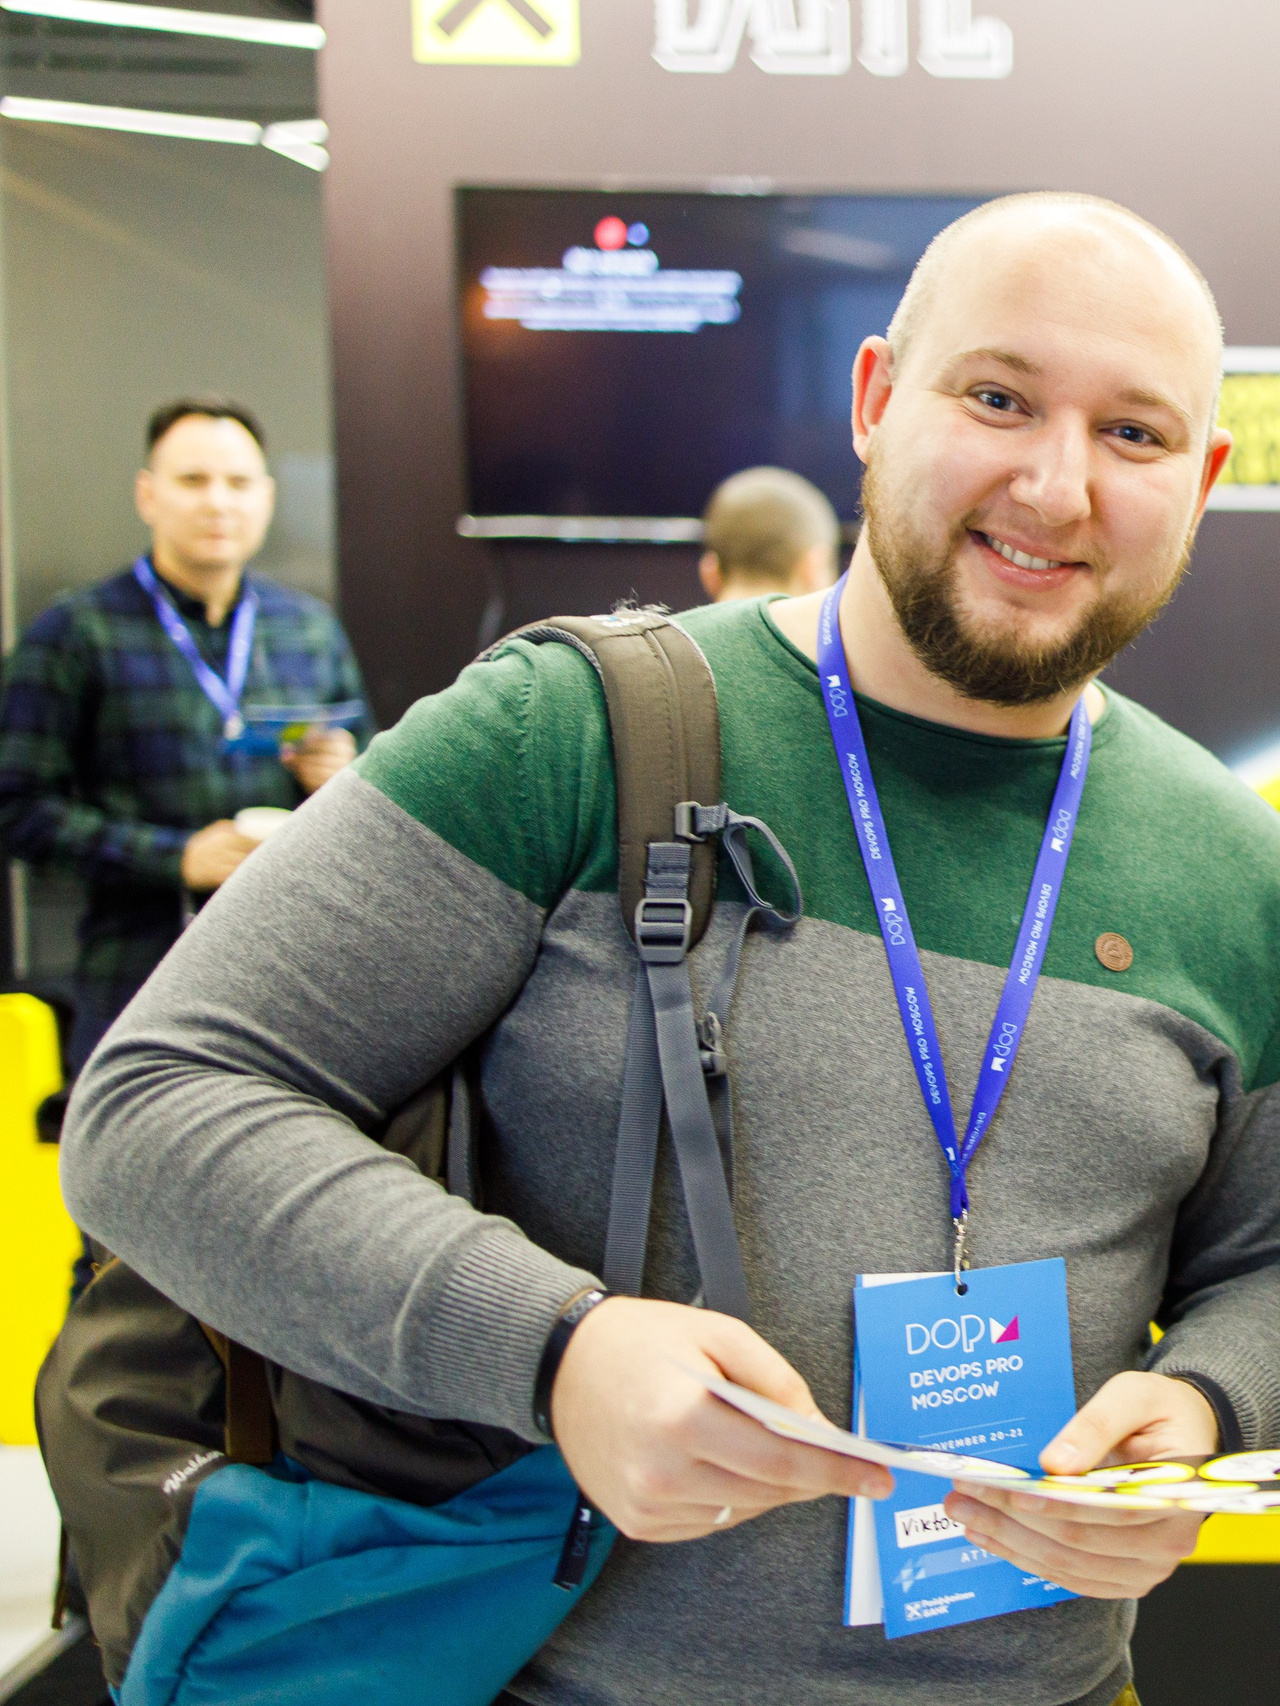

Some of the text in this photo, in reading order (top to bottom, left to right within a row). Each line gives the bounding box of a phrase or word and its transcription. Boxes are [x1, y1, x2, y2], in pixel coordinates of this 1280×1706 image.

[847, 753, 881, 860] DEVOPS PRO MOSCOW
[1018, 883, 1052, 985] DEVOPS PRO MOSCOW
[904, 986, 941, 1105] DEVOPS PRO MOSCOW
[993, 1022, 1018, 1057] DOP
[905, 1314, 985, 1355] DOP
[909, 1354, 1024, 1389] DEVOPS PRO
[911, 1380, 1000, 1411] MOSCOW
[926, 1434, 987, 1451] OVEMBER
[960, 1548, 996, 1563] ATT
